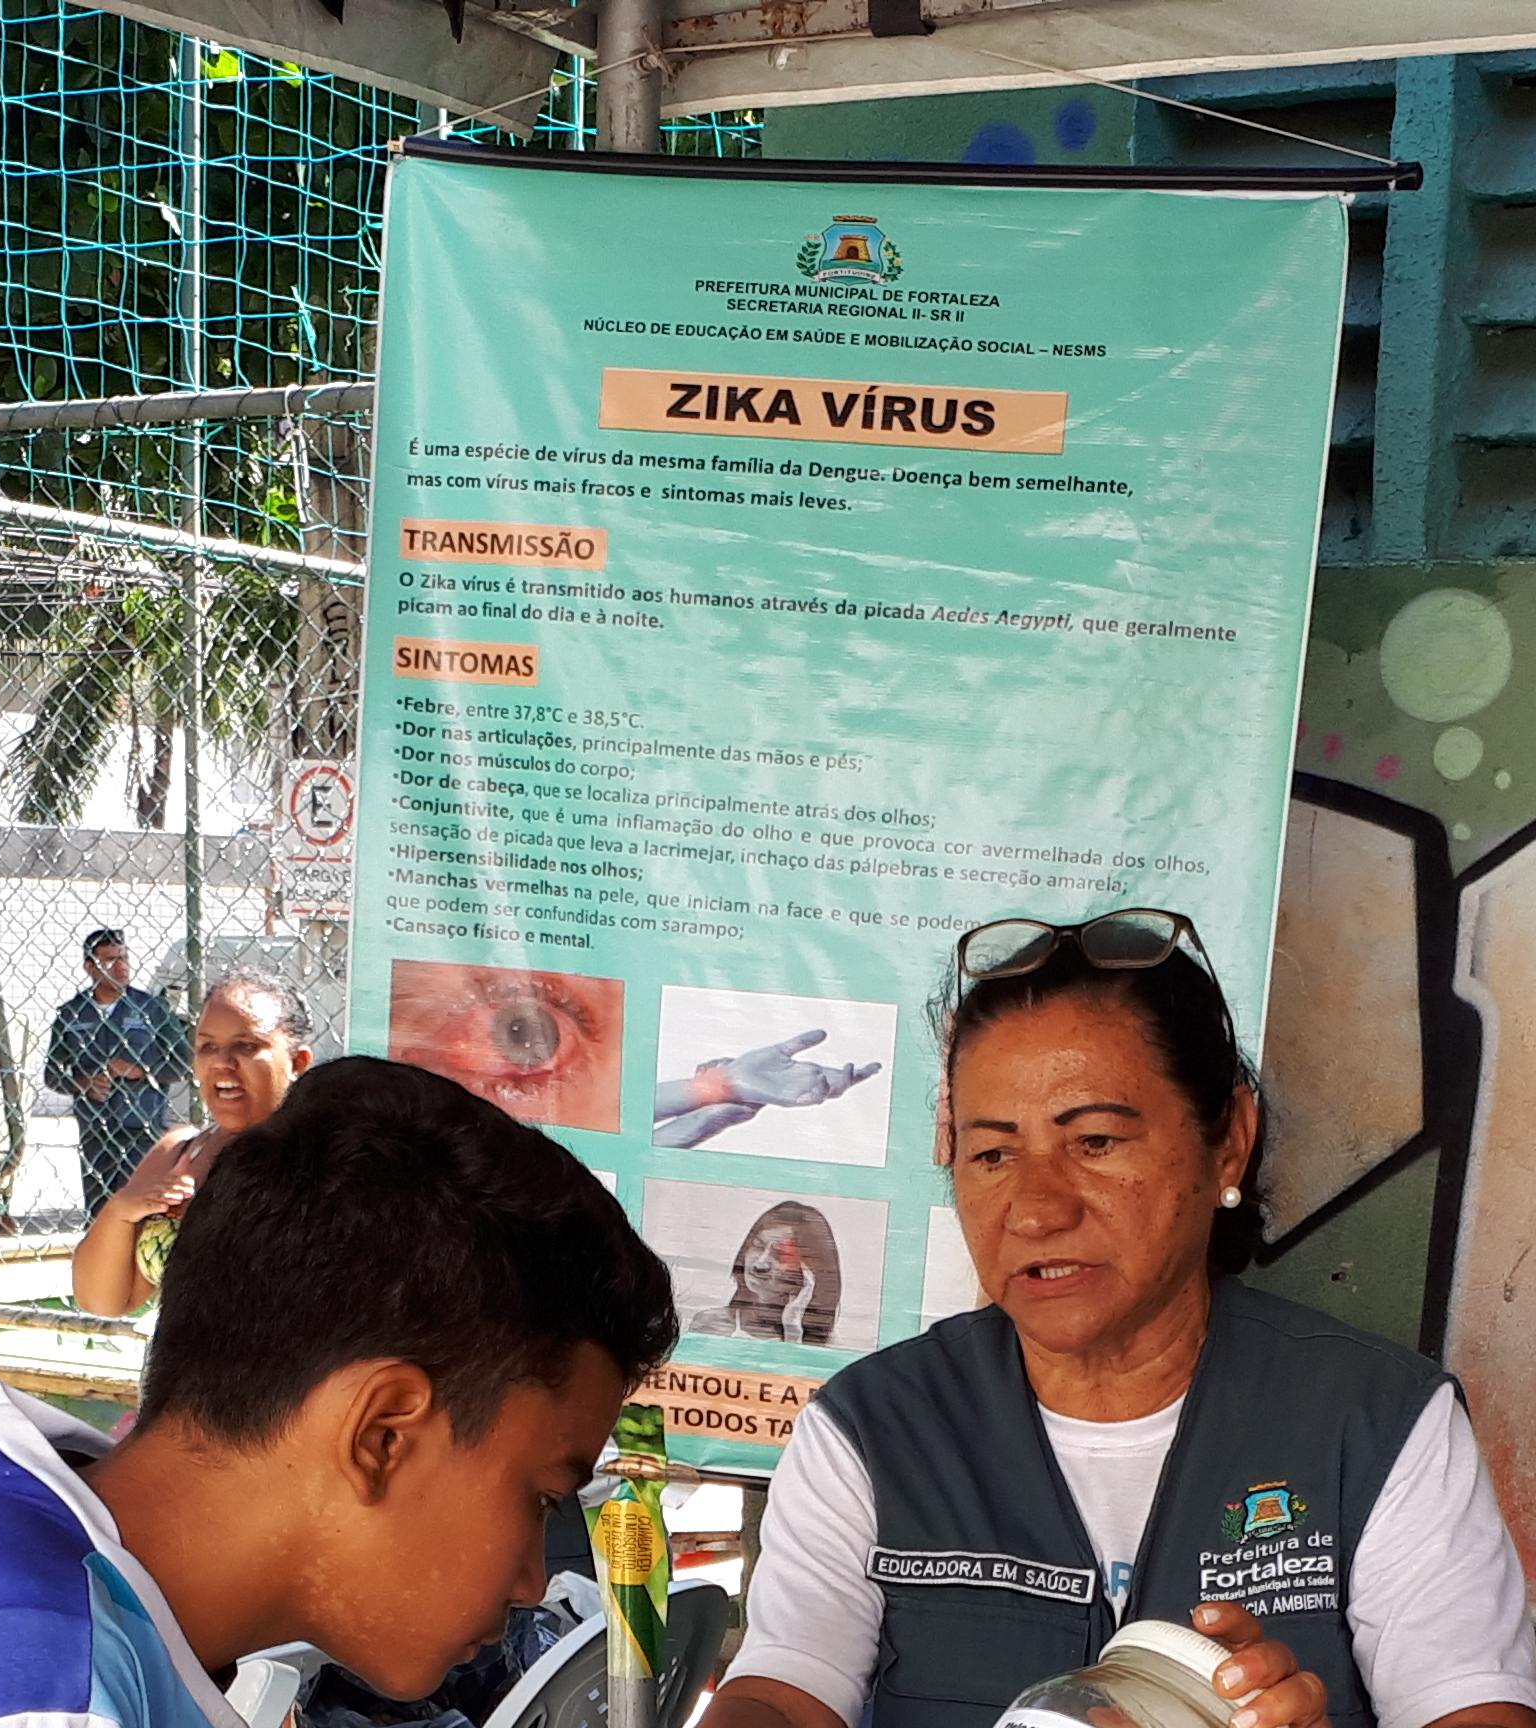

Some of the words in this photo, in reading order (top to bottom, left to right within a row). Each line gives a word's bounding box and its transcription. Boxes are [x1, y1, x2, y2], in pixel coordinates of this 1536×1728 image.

[693, 279, 793, 299] PREFEITURA
[794, 283, 879, 303] MUNICIPAL
[881, 288, 905, 305] DE
[906, 289, 1002, 309] FORTALEZA
[725, 298, 823, 316] SECRETARIA
[827, 303, 908, 320] REGIONAL
[929, 308, 952, 322] SR
[955, 310, 965, 323] II
[583, 316, 647, 334] NÚCLEO
[650, 322, 671, 336] DE
[674, 323, 763, 342] EDUCAÇÃO
[765, 328, 789, 342] EM
[792, 328, 846, 345] SAÚDE
[849, 333, 861, 346] E
[864, 333, 973, 353] MOBILIZAÇÃO
[976, 340, 1035, 355] SOCIAL
[1052, 344, 1107, 358] NESMS
[665, 382, 802, 426] ZIKA
[821, 385, 996, 437] VÍRUS
[408, 436, 419, 456] É
[424, 444, 460, 457] uma
[464, 442, 530, 462] espécie
[534, 445, 558, 463] de
[562, 446, 607, 465] vírus
[611, 449, 634, 466] da
[639, 455, 706, 471] mesma
[711, 454, 775, 475] família
[779, 459, 803, 477] da
[808, 461, 886, 484] Dengue.
[891, 467, 963, 490] Doença
[968, 470, 1011, 489] bem
[1015, 475, 1134, 498] semelhante,
[403, 528, 595, 561] TRANSMISSÃO
[396, 646, 534, 678] SINTOMAS
[403, 696, 461, 718] Febre,
[465, 704, 510, 720] entre
[567, 711, 578, 724] e
[310, 786, 333, 829] E
[759, 1382, 773, 1403] E
[779, 1386, 799, 1406] A
[668, 1406, 758, 1435] TODOS
[1199, 1535, 1300, 1567] Prefeitura
[1307, 1530, 1334, 1548] de
[877, 1558, 983, 1579] EDUCADORA
[992, 1562, 1018, 1581] EM
[1024, 1568, 1083, 1594] SAÚDE
[1200, 1553, 1334, 1590] Fortaleza
[1200, 1588, 1247, 1602] Secretaria
[1293, 1577, 1305, 1588] da
[1307, 1574, 1335, 1587] Saúde
